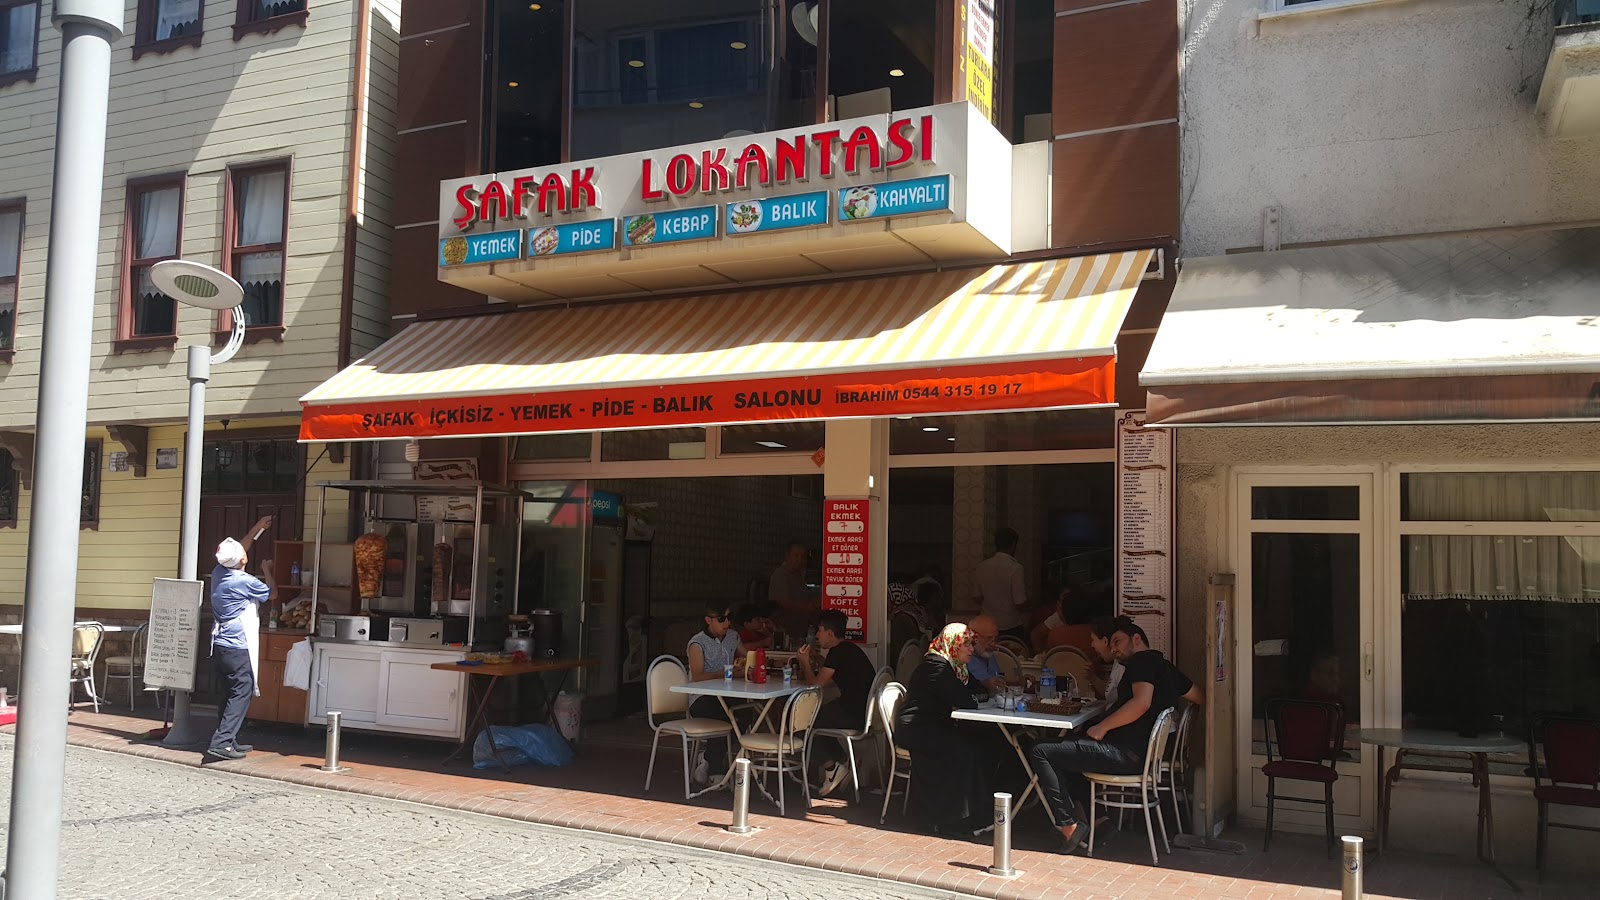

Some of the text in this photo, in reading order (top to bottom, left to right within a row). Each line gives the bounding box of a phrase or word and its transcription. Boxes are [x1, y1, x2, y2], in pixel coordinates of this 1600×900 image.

[973, 69, 986, 97] ÖZEL
[968, 84, 989, 120] İNDİRİM
[454, 115, 936, 231] ŞAFAK LOKANTASI
[879, 183, 946, 208] KAHVALTI
[771, 199, 818, 222] BALIK
[662, 212, 710, 234] KEBAP
[472, 237, 517, 256] YEMEK
[571, 225, 602, 247] PİDE
[362, 410, 415, 431] ŞAFAK
[430, 404, 494, 428] İÇKİSİZ
[510, 403, 573, 421] YEMEK
[592, 397, 635, 417] PİDE
[653, 394, 714, 413] BALIK
[734, 388, 822, 409] SALONU
[835, 387, 899, 404] İBRAHİM
[903, 386, 940, 400] 0544
[944, 384, 973, 397] 315
[978, 383, 997, 396] 19
[1002, 382, 1022, 395] 17
[593, 499, 611, 510] pepsi
[839, 521, 848, 531] 7
[840, 543, 858, 551] DÖNER
[839, 553, 851, 564] 10
[830, 596, 858, 606] KÖFTE
[840, 586, 847, 596] 5
